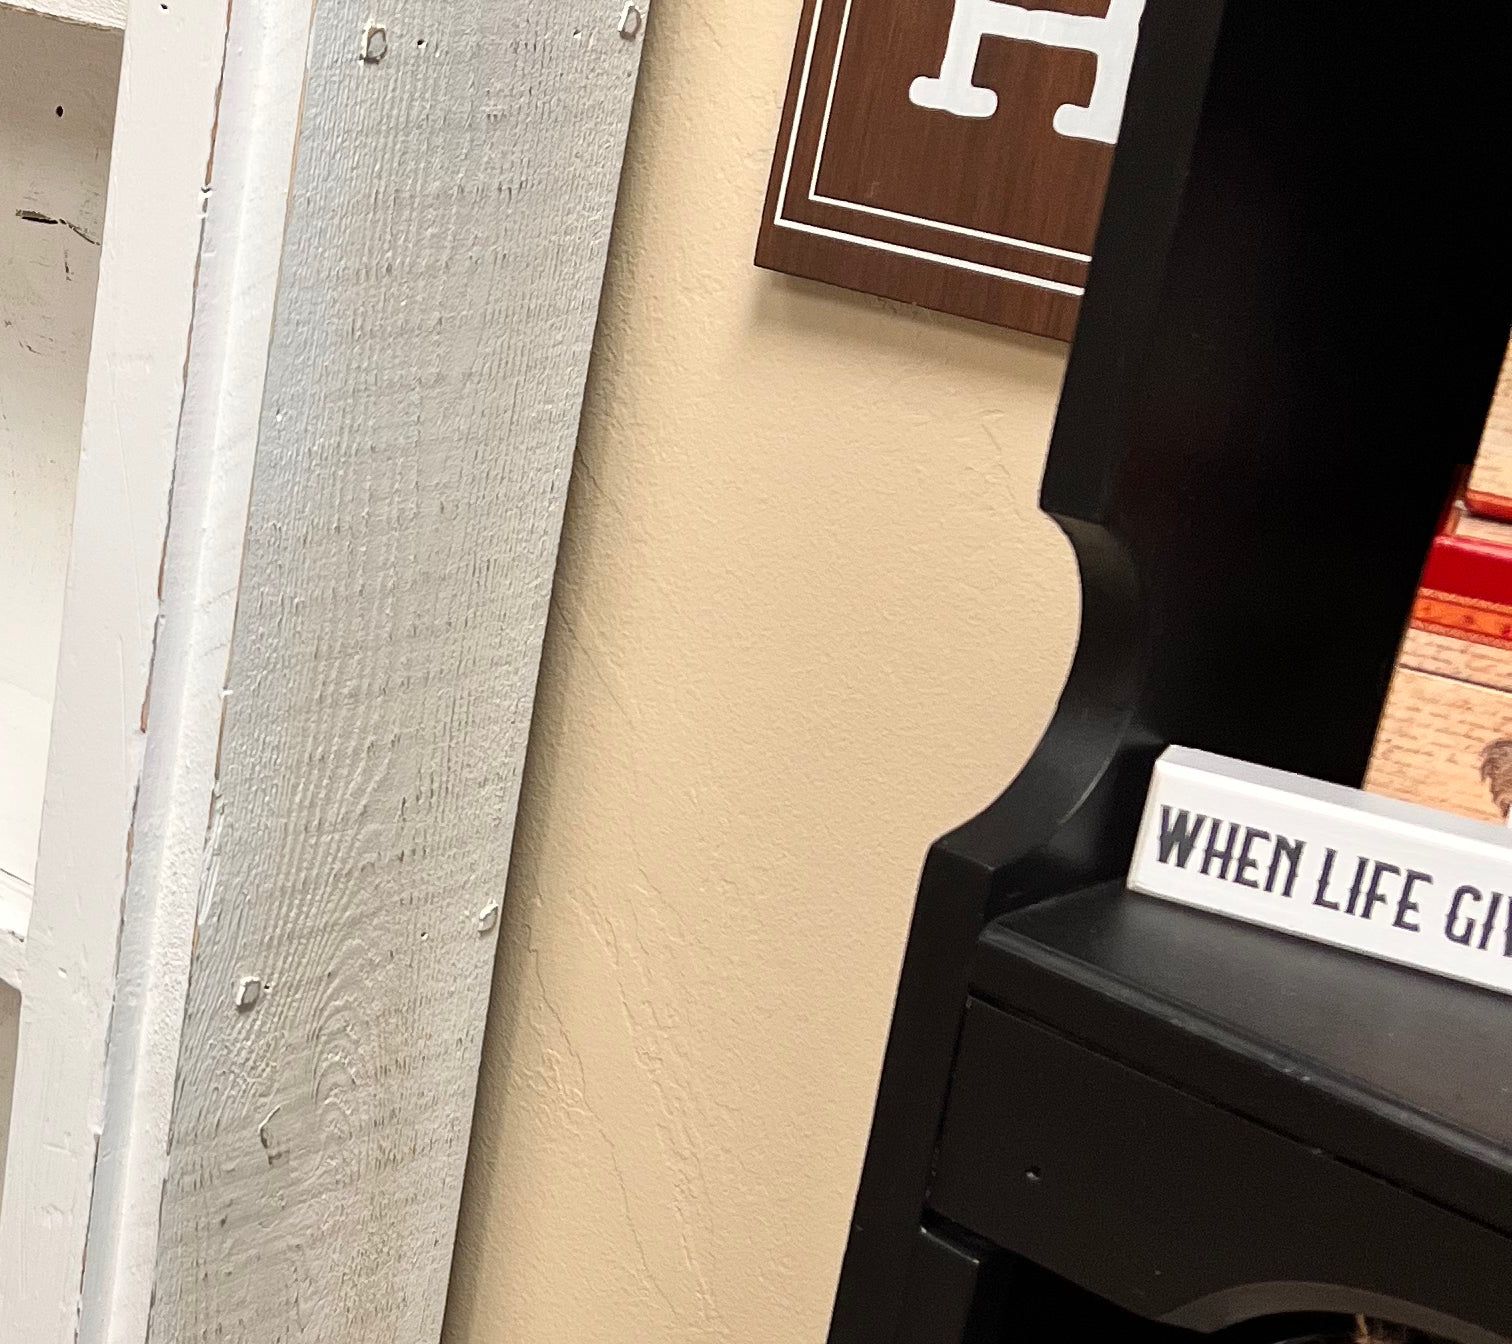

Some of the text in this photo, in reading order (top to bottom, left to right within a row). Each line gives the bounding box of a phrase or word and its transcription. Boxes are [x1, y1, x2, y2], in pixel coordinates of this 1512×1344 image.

[1156, 803, 1512, 957] WHEN LIFE GI
